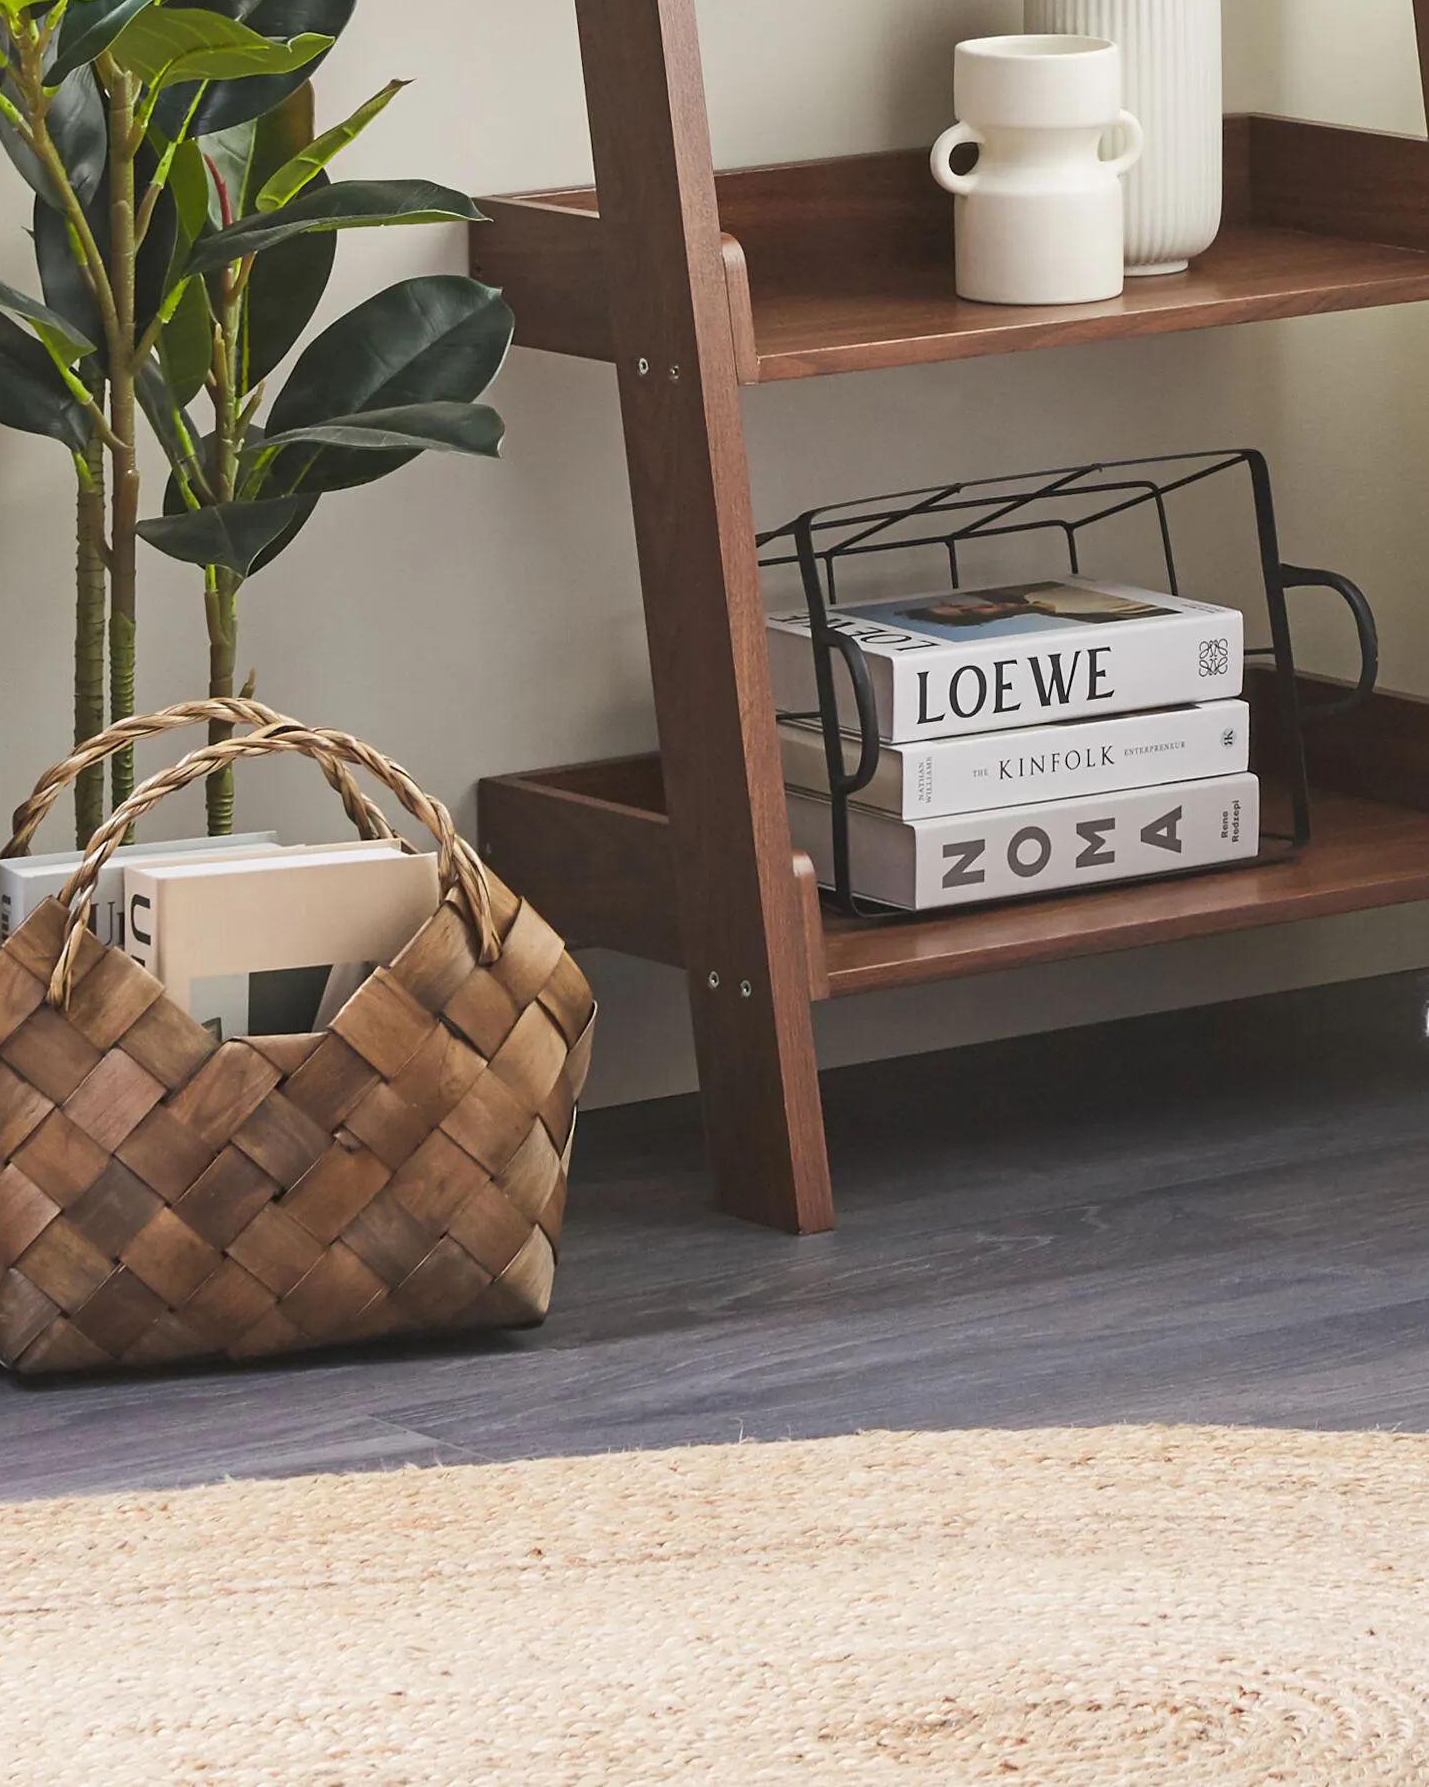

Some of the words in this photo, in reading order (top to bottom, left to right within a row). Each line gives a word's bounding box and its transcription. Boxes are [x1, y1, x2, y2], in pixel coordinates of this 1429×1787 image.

[917, 646, 1115, 725] LOEWE
[972, 768, 989, 777] THE
[999, 745, 1115, 780] KINFOLK
[941, 805, 1183, 889] NOMA
